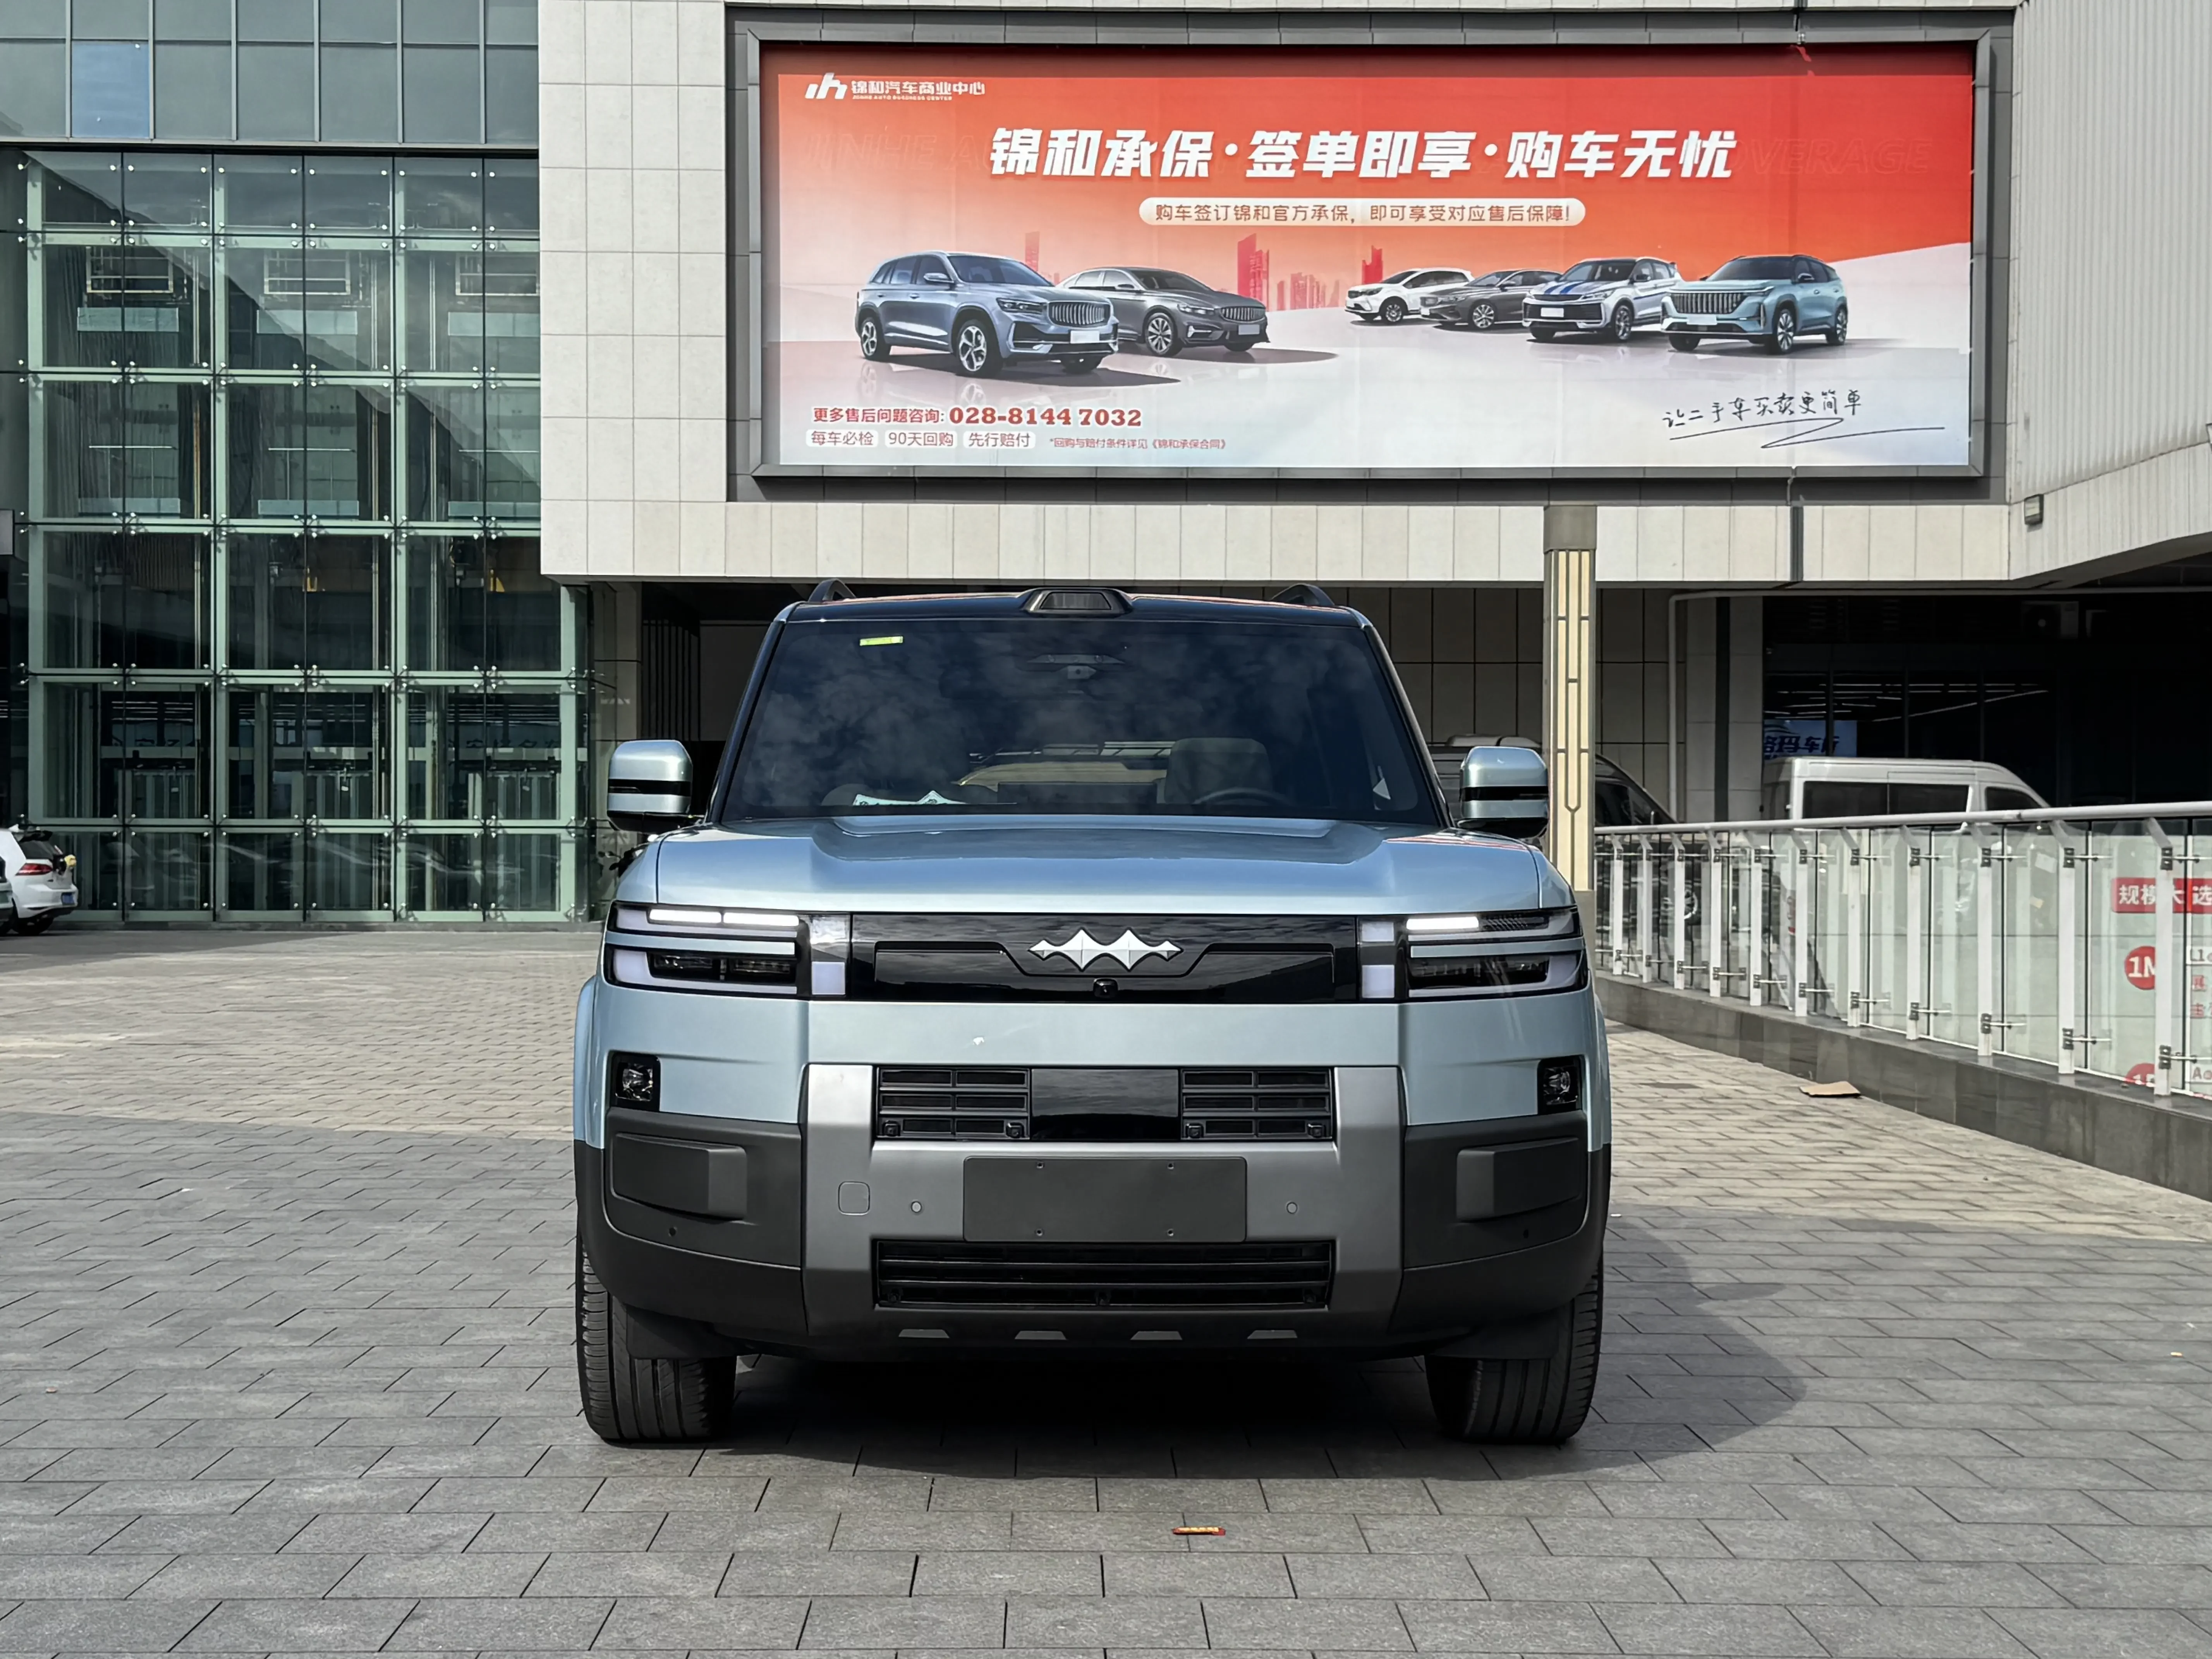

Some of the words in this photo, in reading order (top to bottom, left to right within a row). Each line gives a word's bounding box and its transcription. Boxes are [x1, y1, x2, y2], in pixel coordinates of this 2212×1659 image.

[851, 81, 985, 95] 锦和汽车商业中心
[990, 127, 1736, 178] 锦和承保·签单即享·购车无忧
[949, 407, 1072, 425] 028-8144
[1079, 409, 1142, 426] 7032
[811, 431, 874, 446] 每车必检
[889, 432, 953, 447] 90天回购
[969, 432, 1030, 447] 先行赔付
